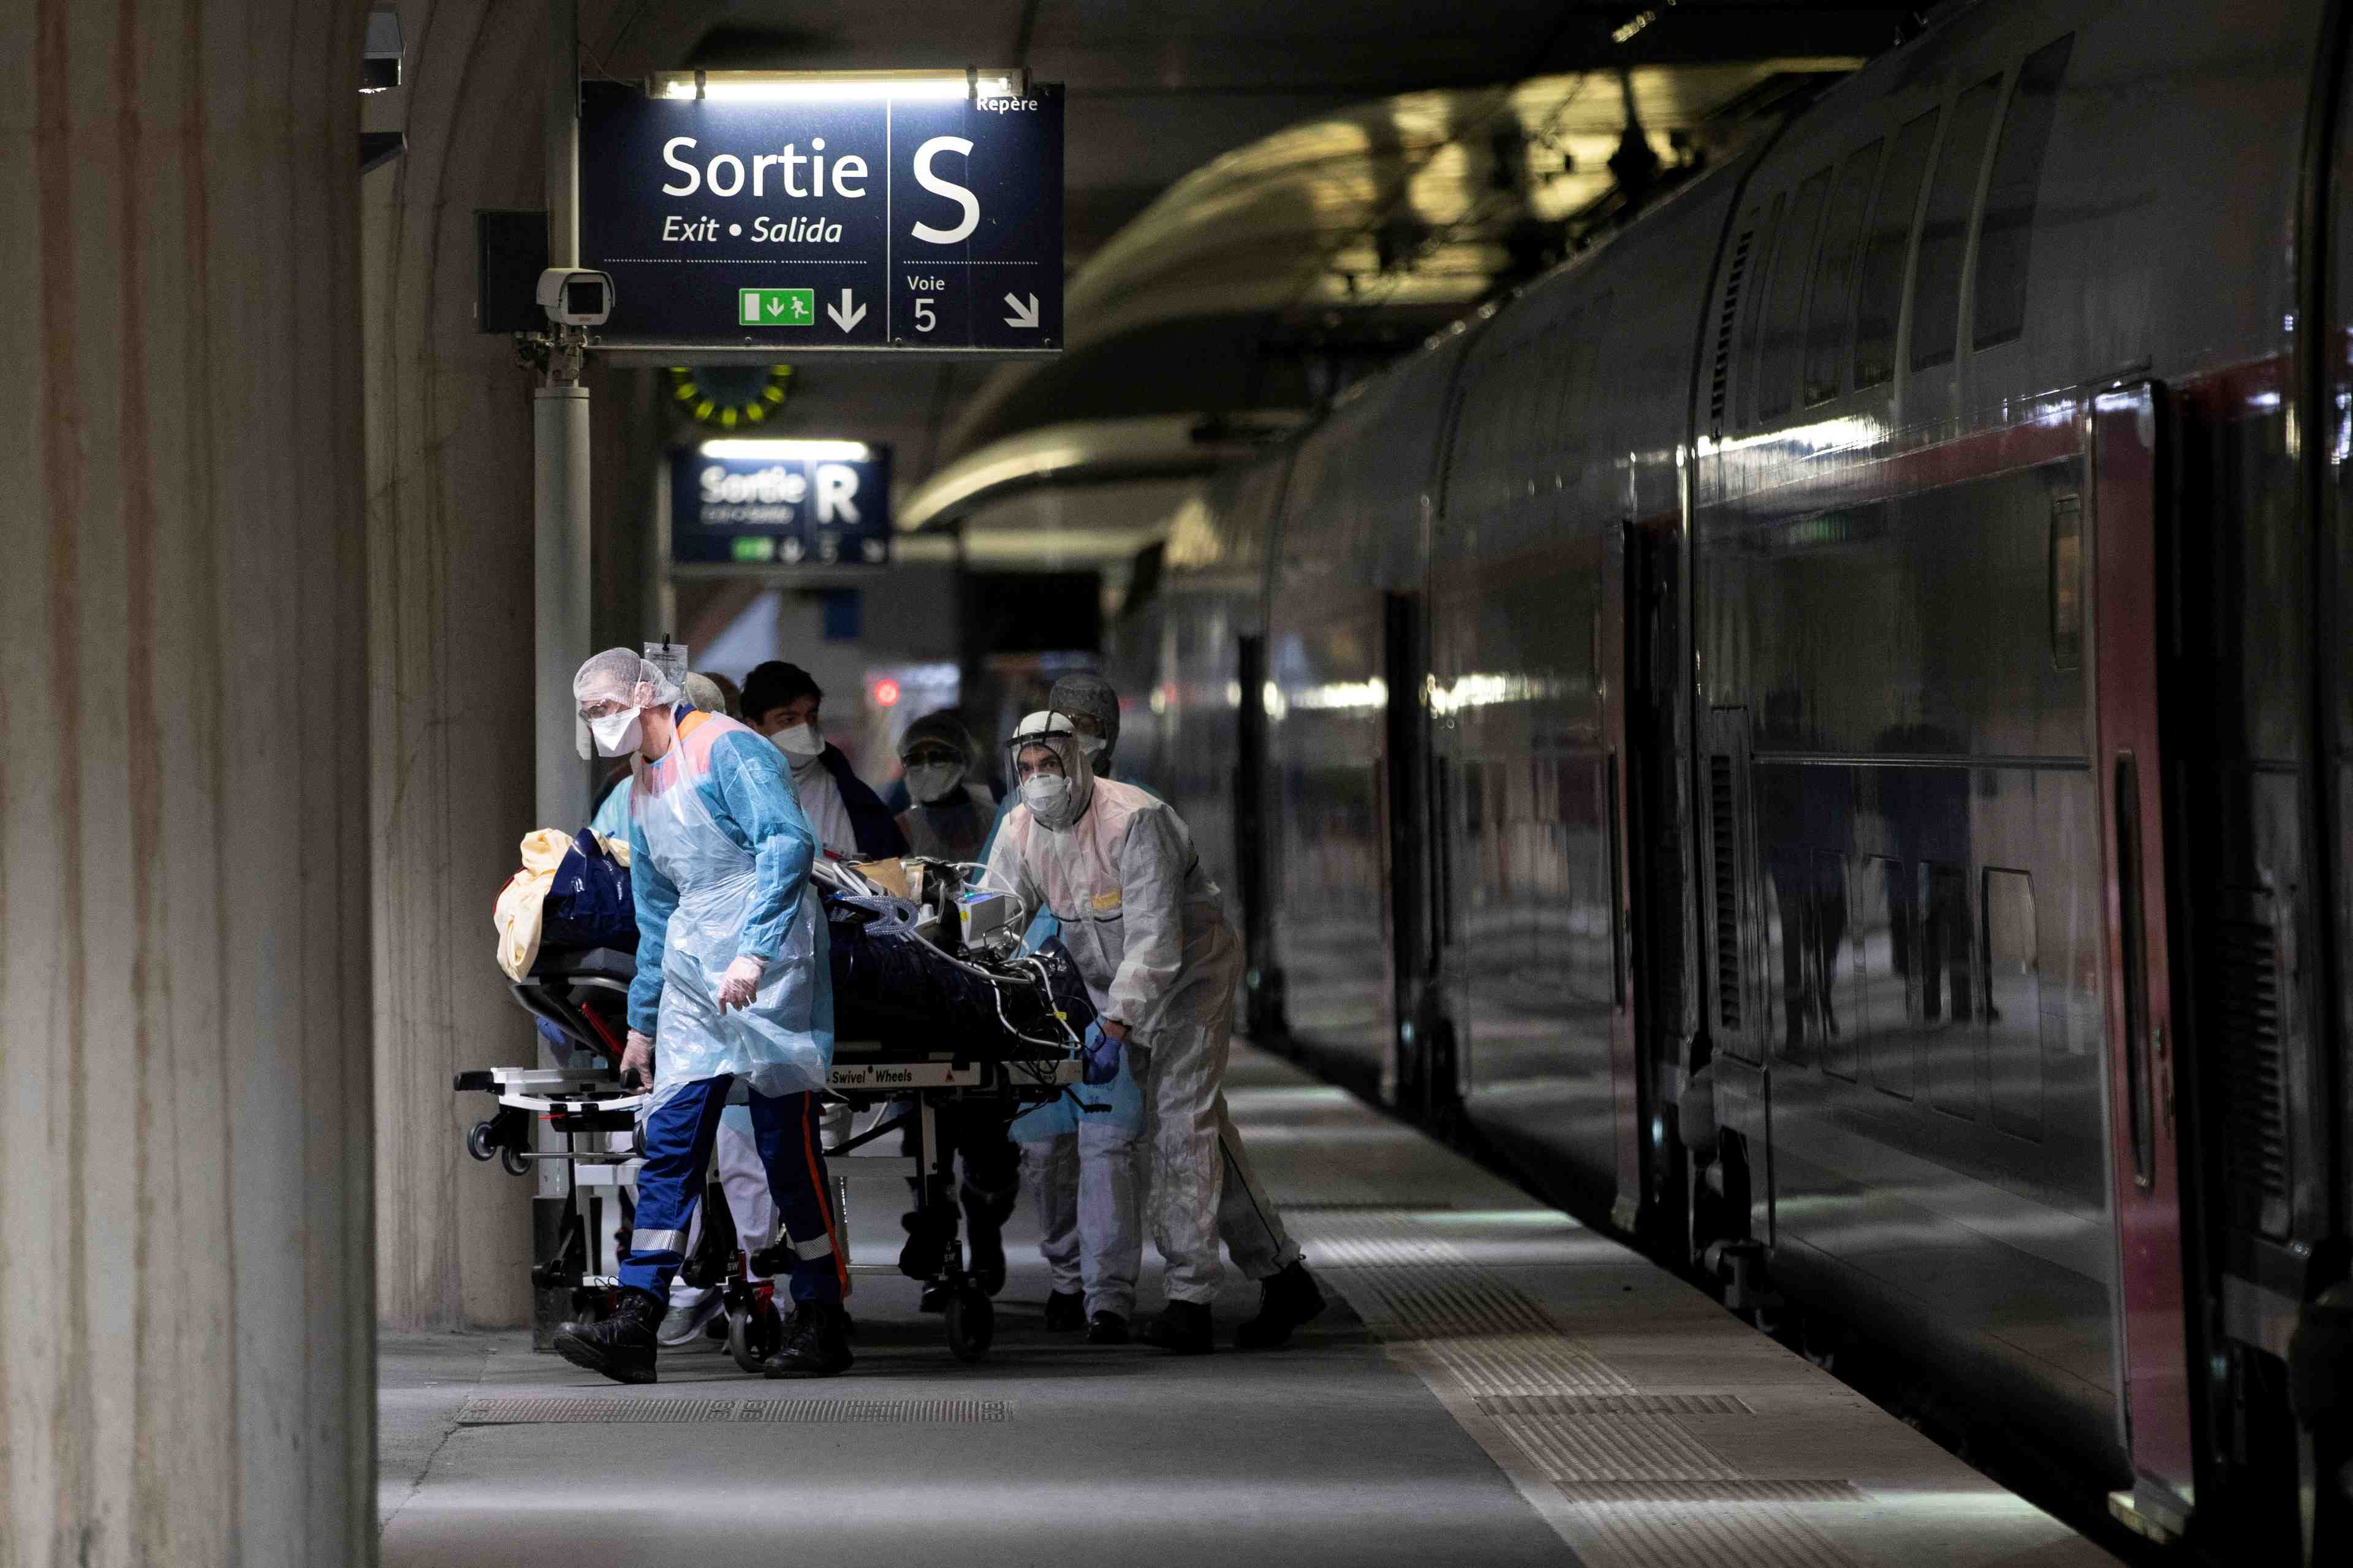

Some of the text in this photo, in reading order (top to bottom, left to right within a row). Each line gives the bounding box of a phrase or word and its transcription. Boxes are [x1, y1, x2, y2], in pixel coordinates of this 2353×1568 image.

[977, 96, 1037, 115] Repère
[662, 136, 868, 198] Sortie
[911, 135, 980, 244] S
[662, 215, 843, 243] Exit Salida
[907, 275, 945, 290] Voie
[915, 298, 936, 332] 5
[817, 464, 859, 523] R
[832, 1070, 866, 1085] Swivel
[876, 1067, 912, 1083] Wheels
